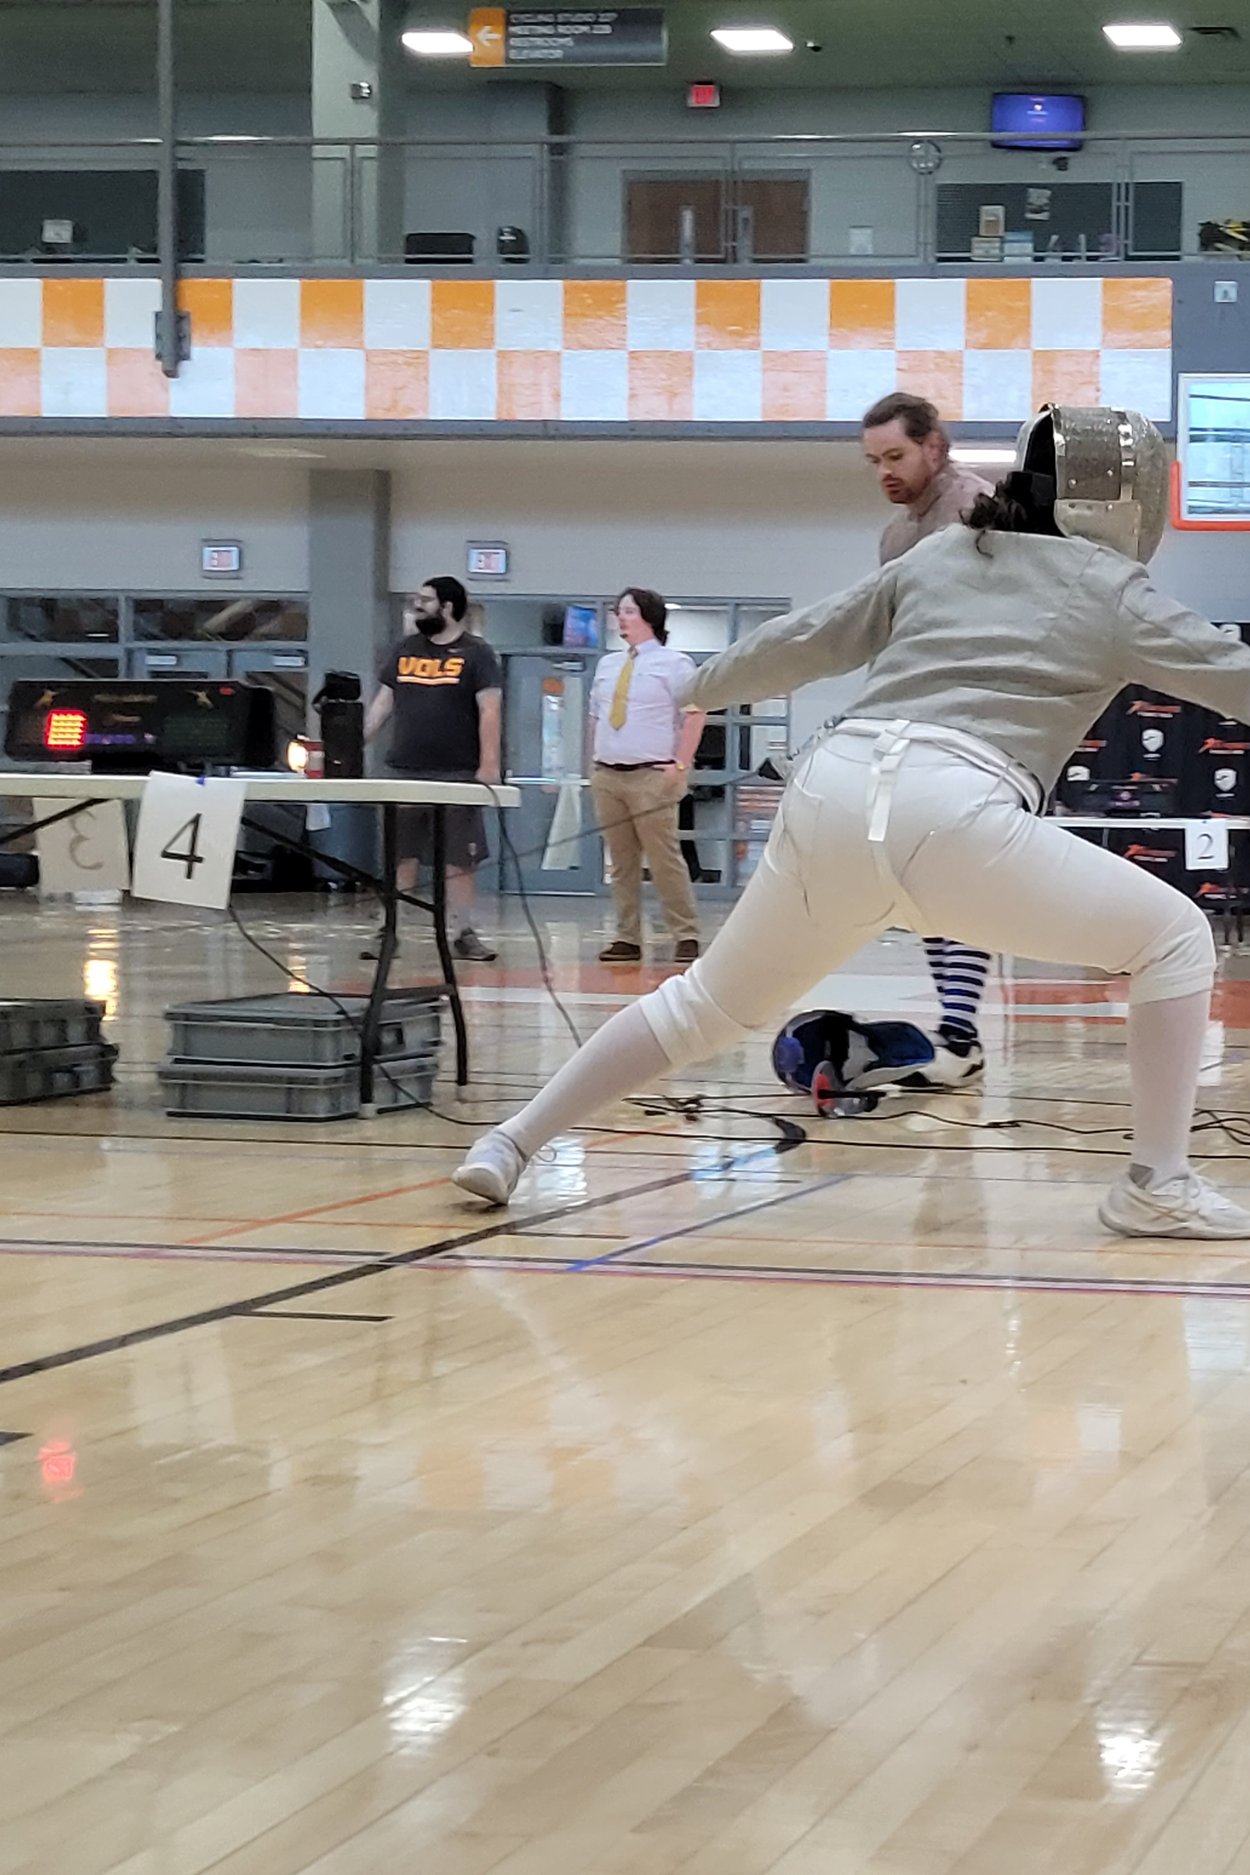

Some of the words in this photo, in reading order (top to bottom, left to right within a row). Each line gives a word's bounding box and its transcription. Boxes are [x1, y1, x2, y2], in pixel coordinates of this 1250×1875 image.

[398, 656, 465, 677] VOLS
[160, 812, 204, 880] 4
[1196, 833, 1215, 860] 2
